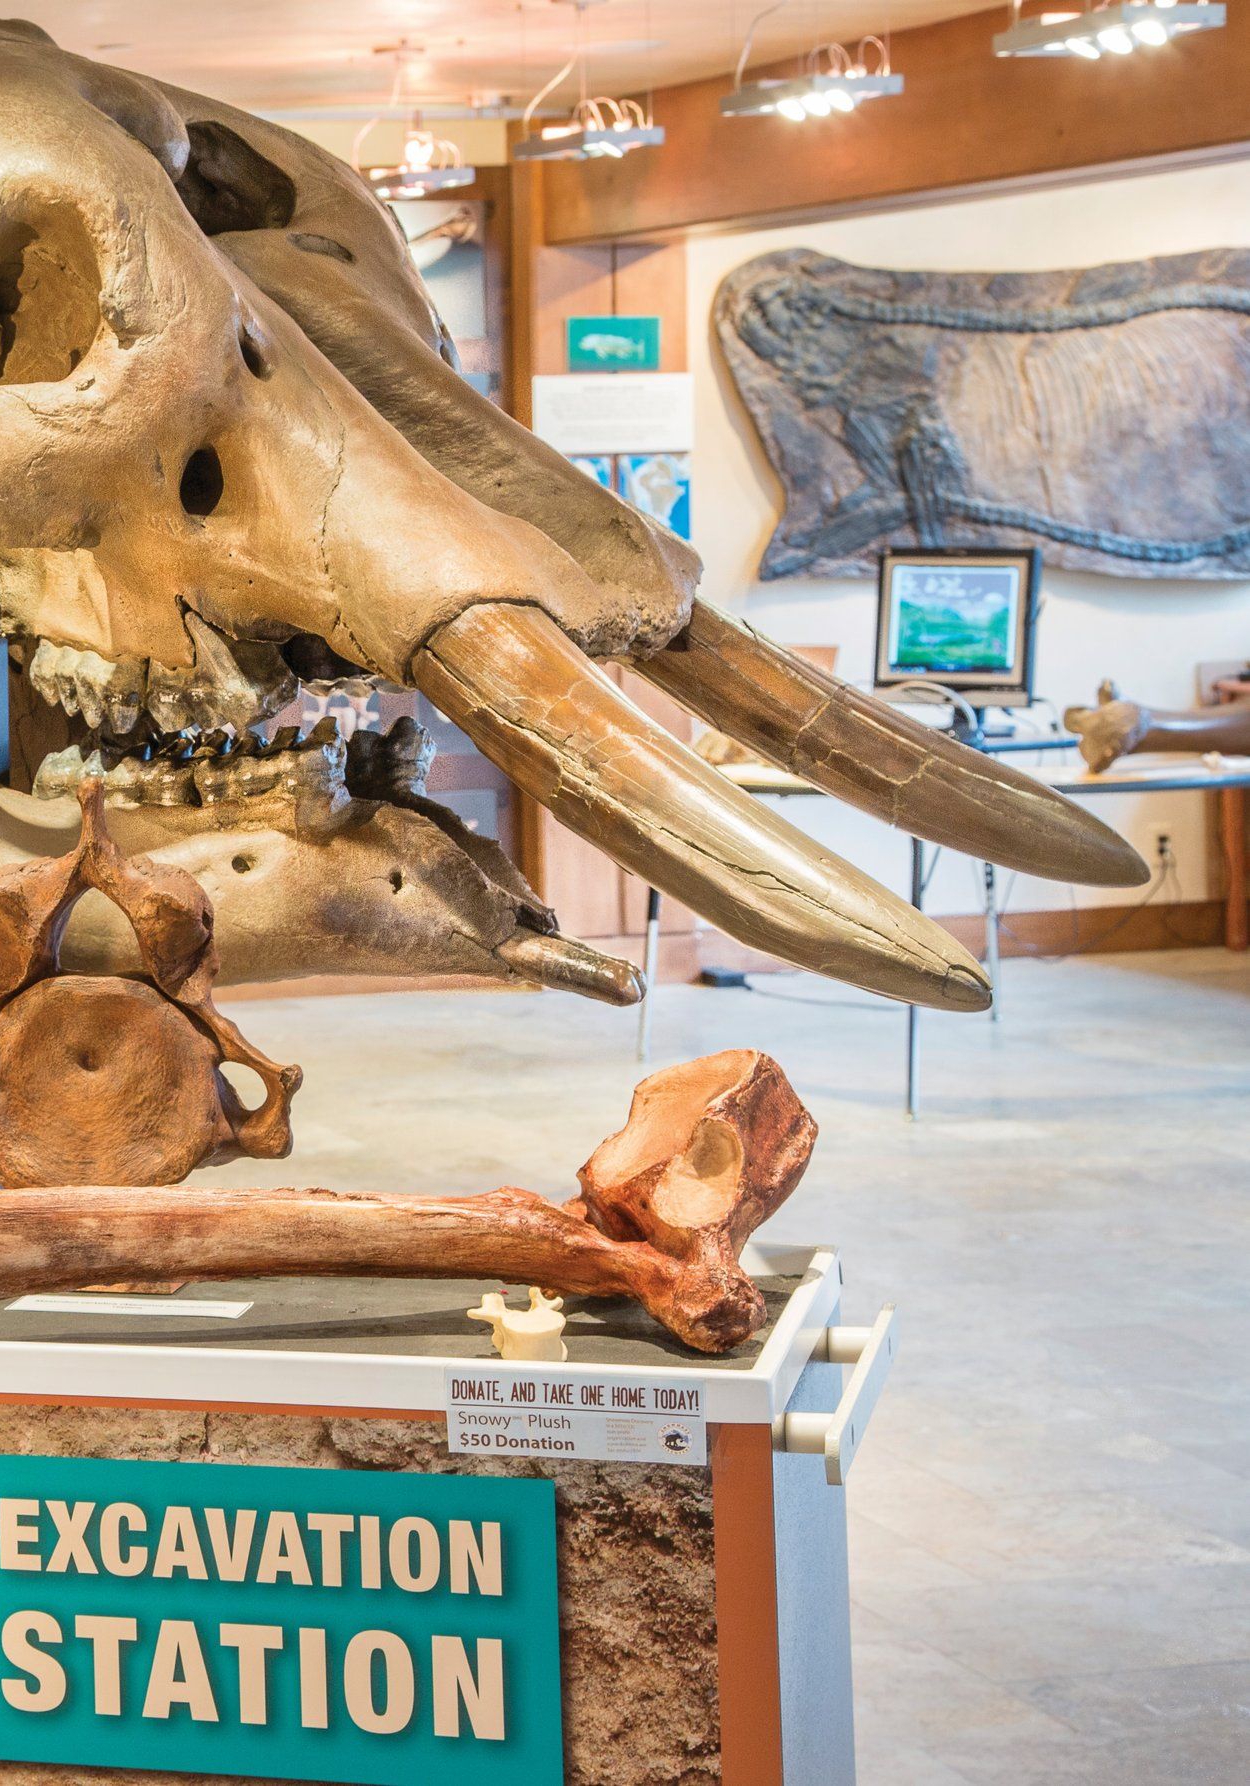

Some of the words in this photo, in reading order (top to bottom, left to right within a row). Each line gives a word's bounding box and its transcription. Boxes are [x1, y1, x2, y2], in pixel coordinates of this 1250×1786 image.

[451, 1378, 504, 1403] DONATE,
[510, 1382, 536, 1403] AND
[542, 1383, 574, 1405] TAKE
[580, 1385, 605, 1406] ONE
[611, 1386, 646, 1408] HOME
[653, 1388, 700, 1411] TODAY!
[458, 1411, 512, 1430] Snowy
[528, 1414, 571, 1430] Plush
[460, 1432, 491, 1448] $50
[495, 1434, 575, 1451] Donation
[0, 1610, 506, 1741] STATION
